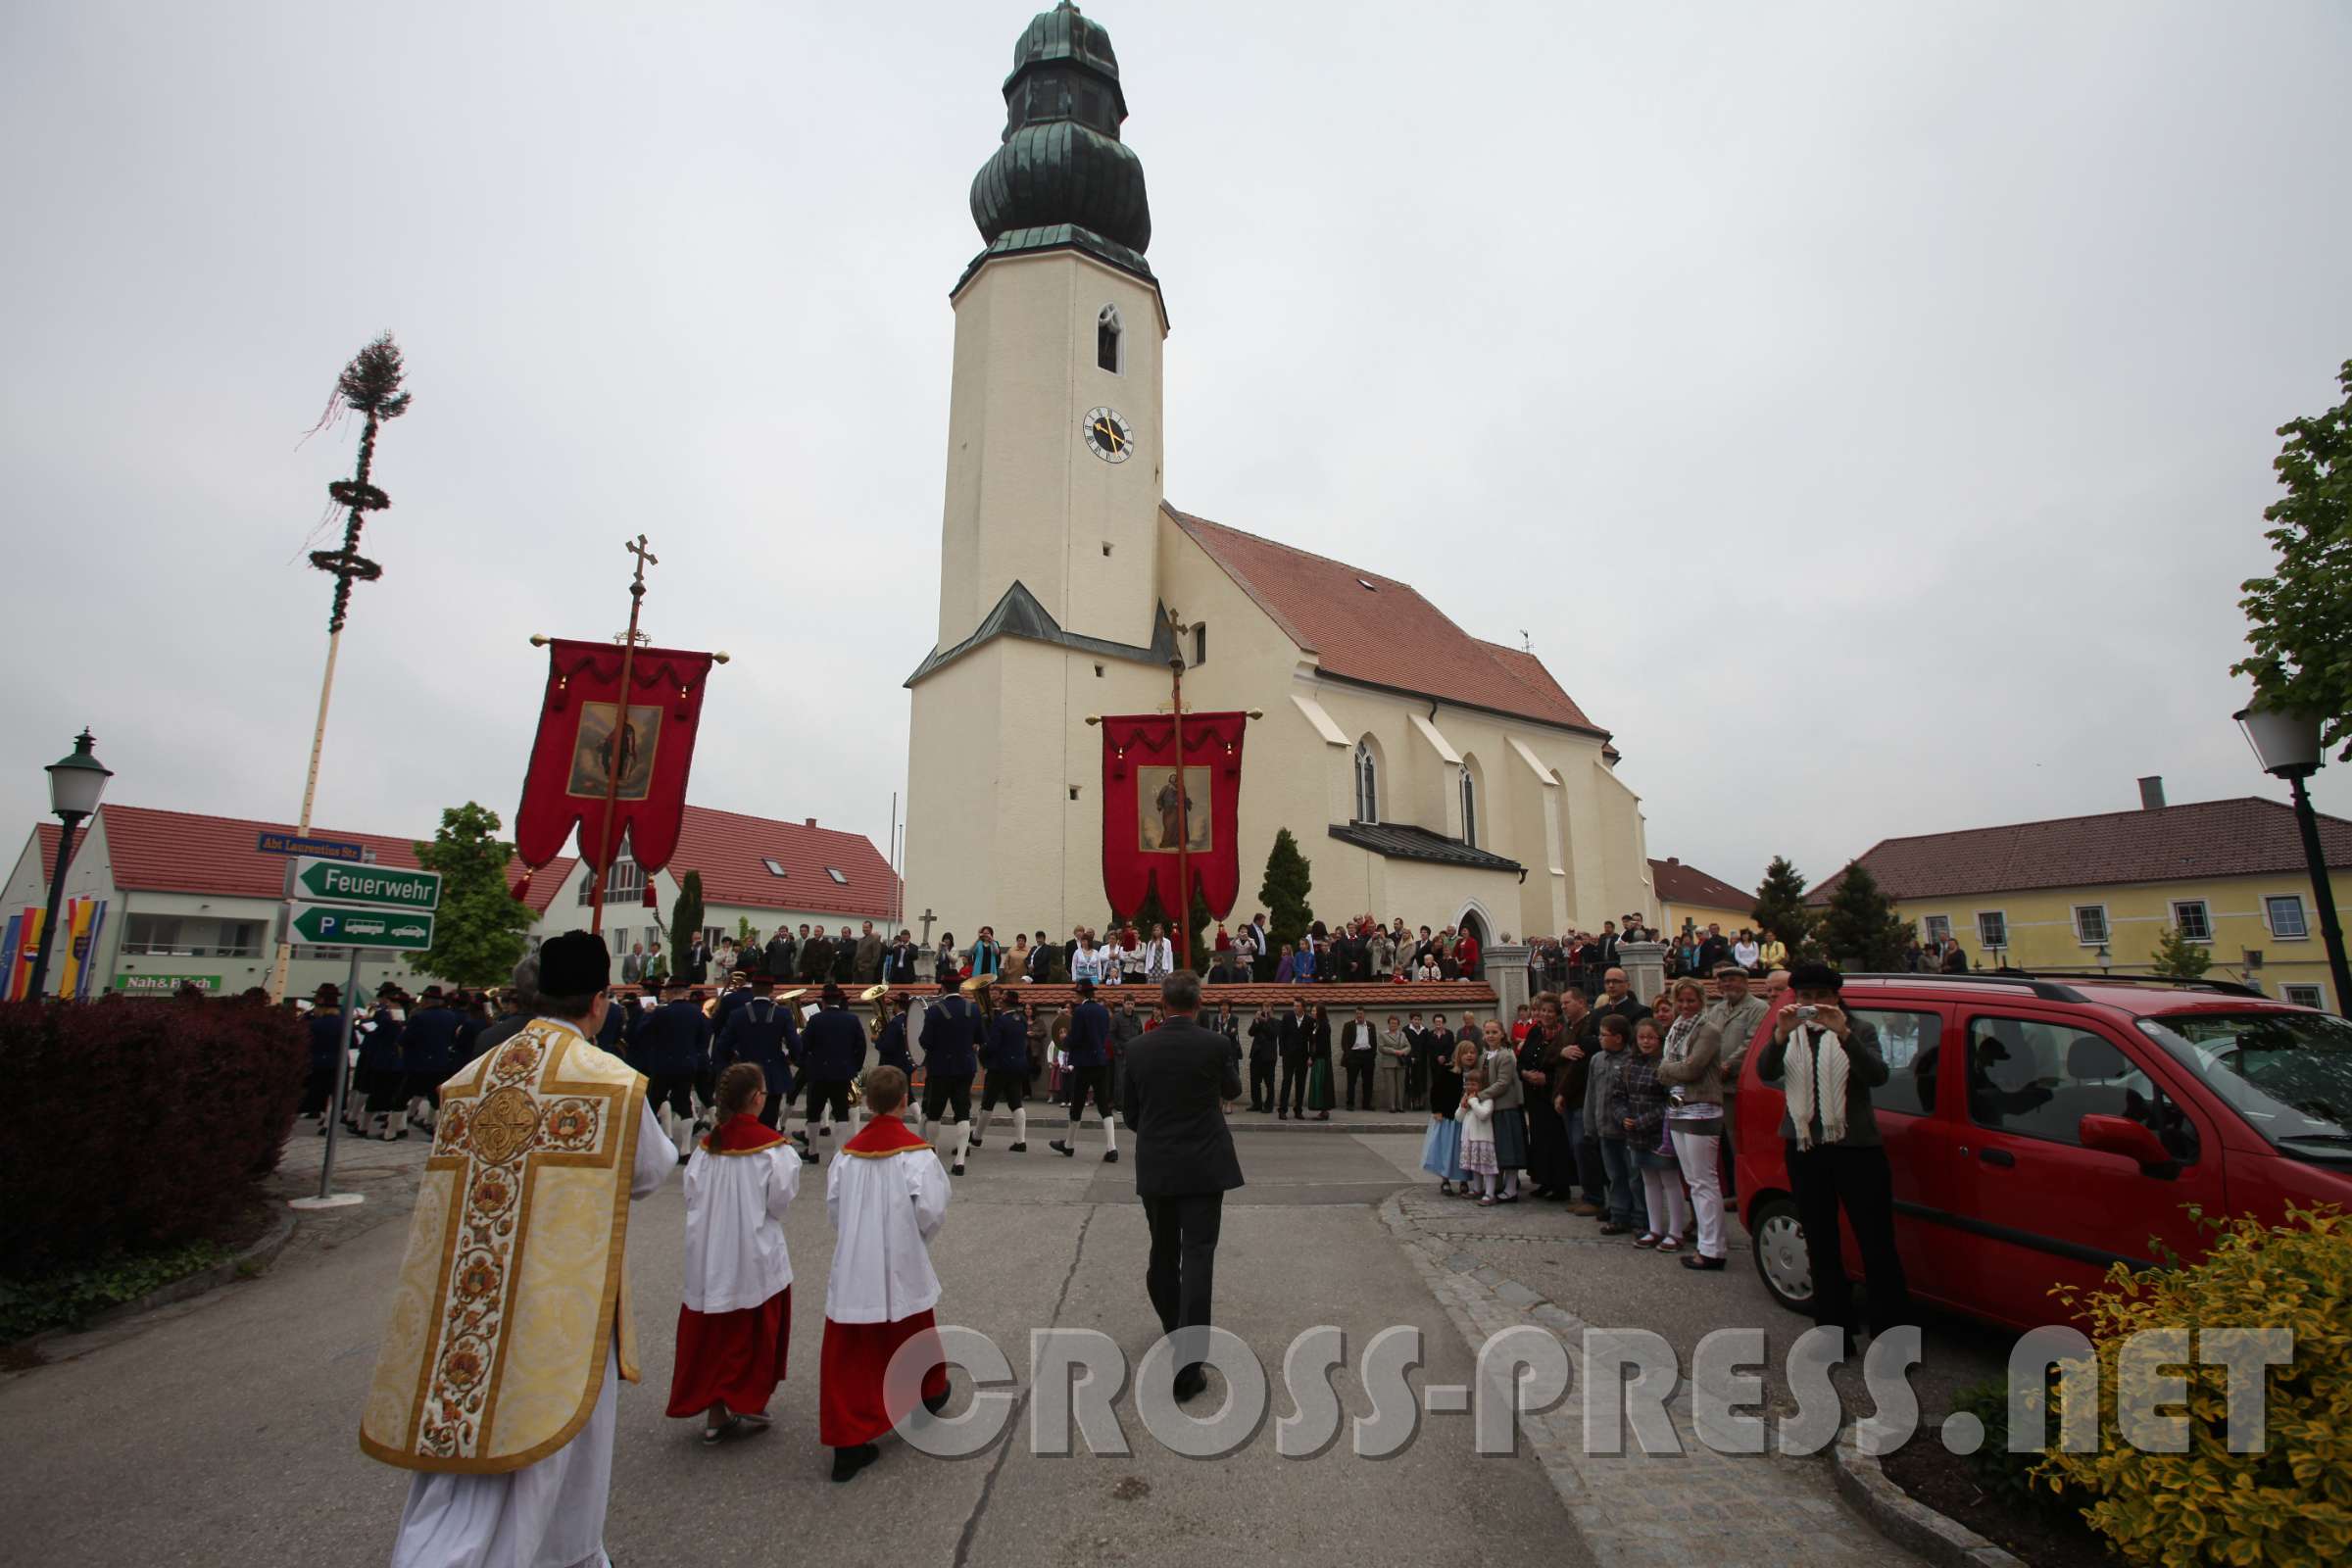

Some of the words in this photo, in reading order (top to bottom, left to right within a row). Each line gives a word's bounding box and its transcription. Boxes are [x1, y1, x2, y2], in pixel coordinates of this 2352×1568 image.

[265, 838, 282, 850] Abt
[285, 839, 340, 857] Laurentius
[324, 868, 433, 901] Feuerwehr
[319, 916, 335, 934] P
